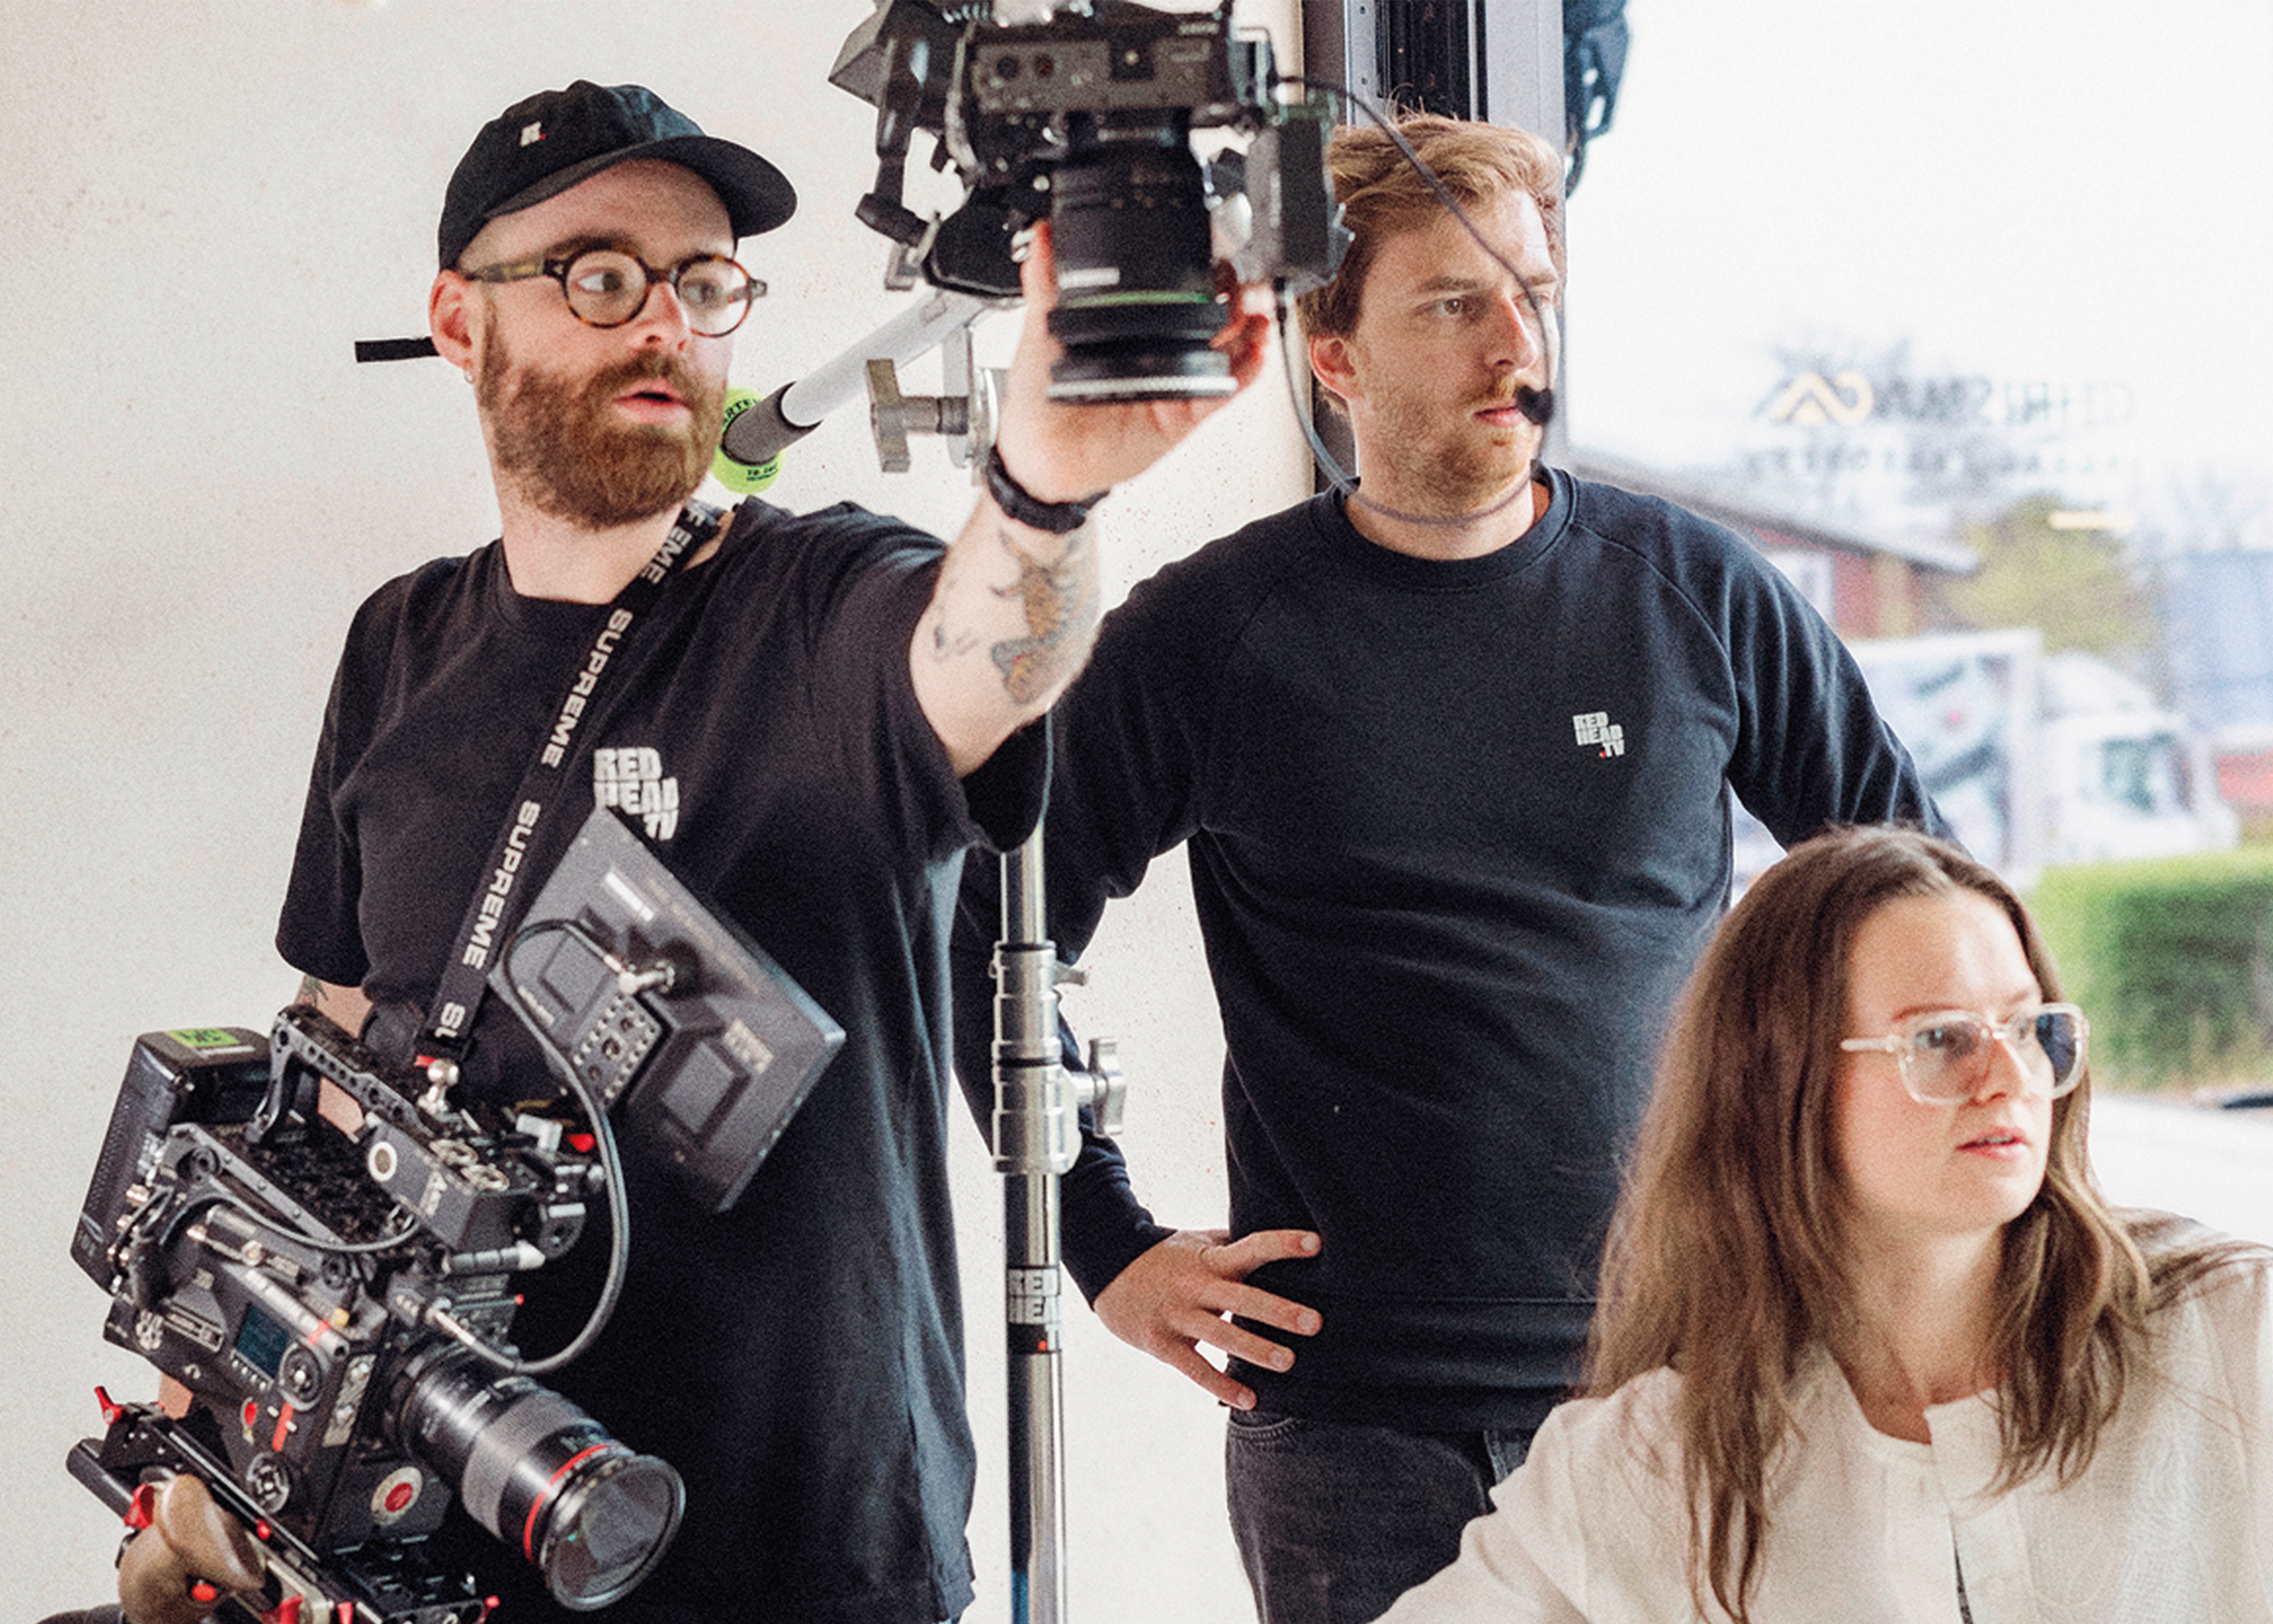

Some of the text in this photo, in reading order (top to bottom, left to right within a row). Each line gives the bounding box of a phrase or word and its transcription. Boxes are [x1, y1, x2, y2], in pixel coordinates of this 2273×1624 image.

[542, 607, 633, 767] SUPREME
[594, 747, 662, 780] RED
[463, 800, 542, 970] SUPREME
